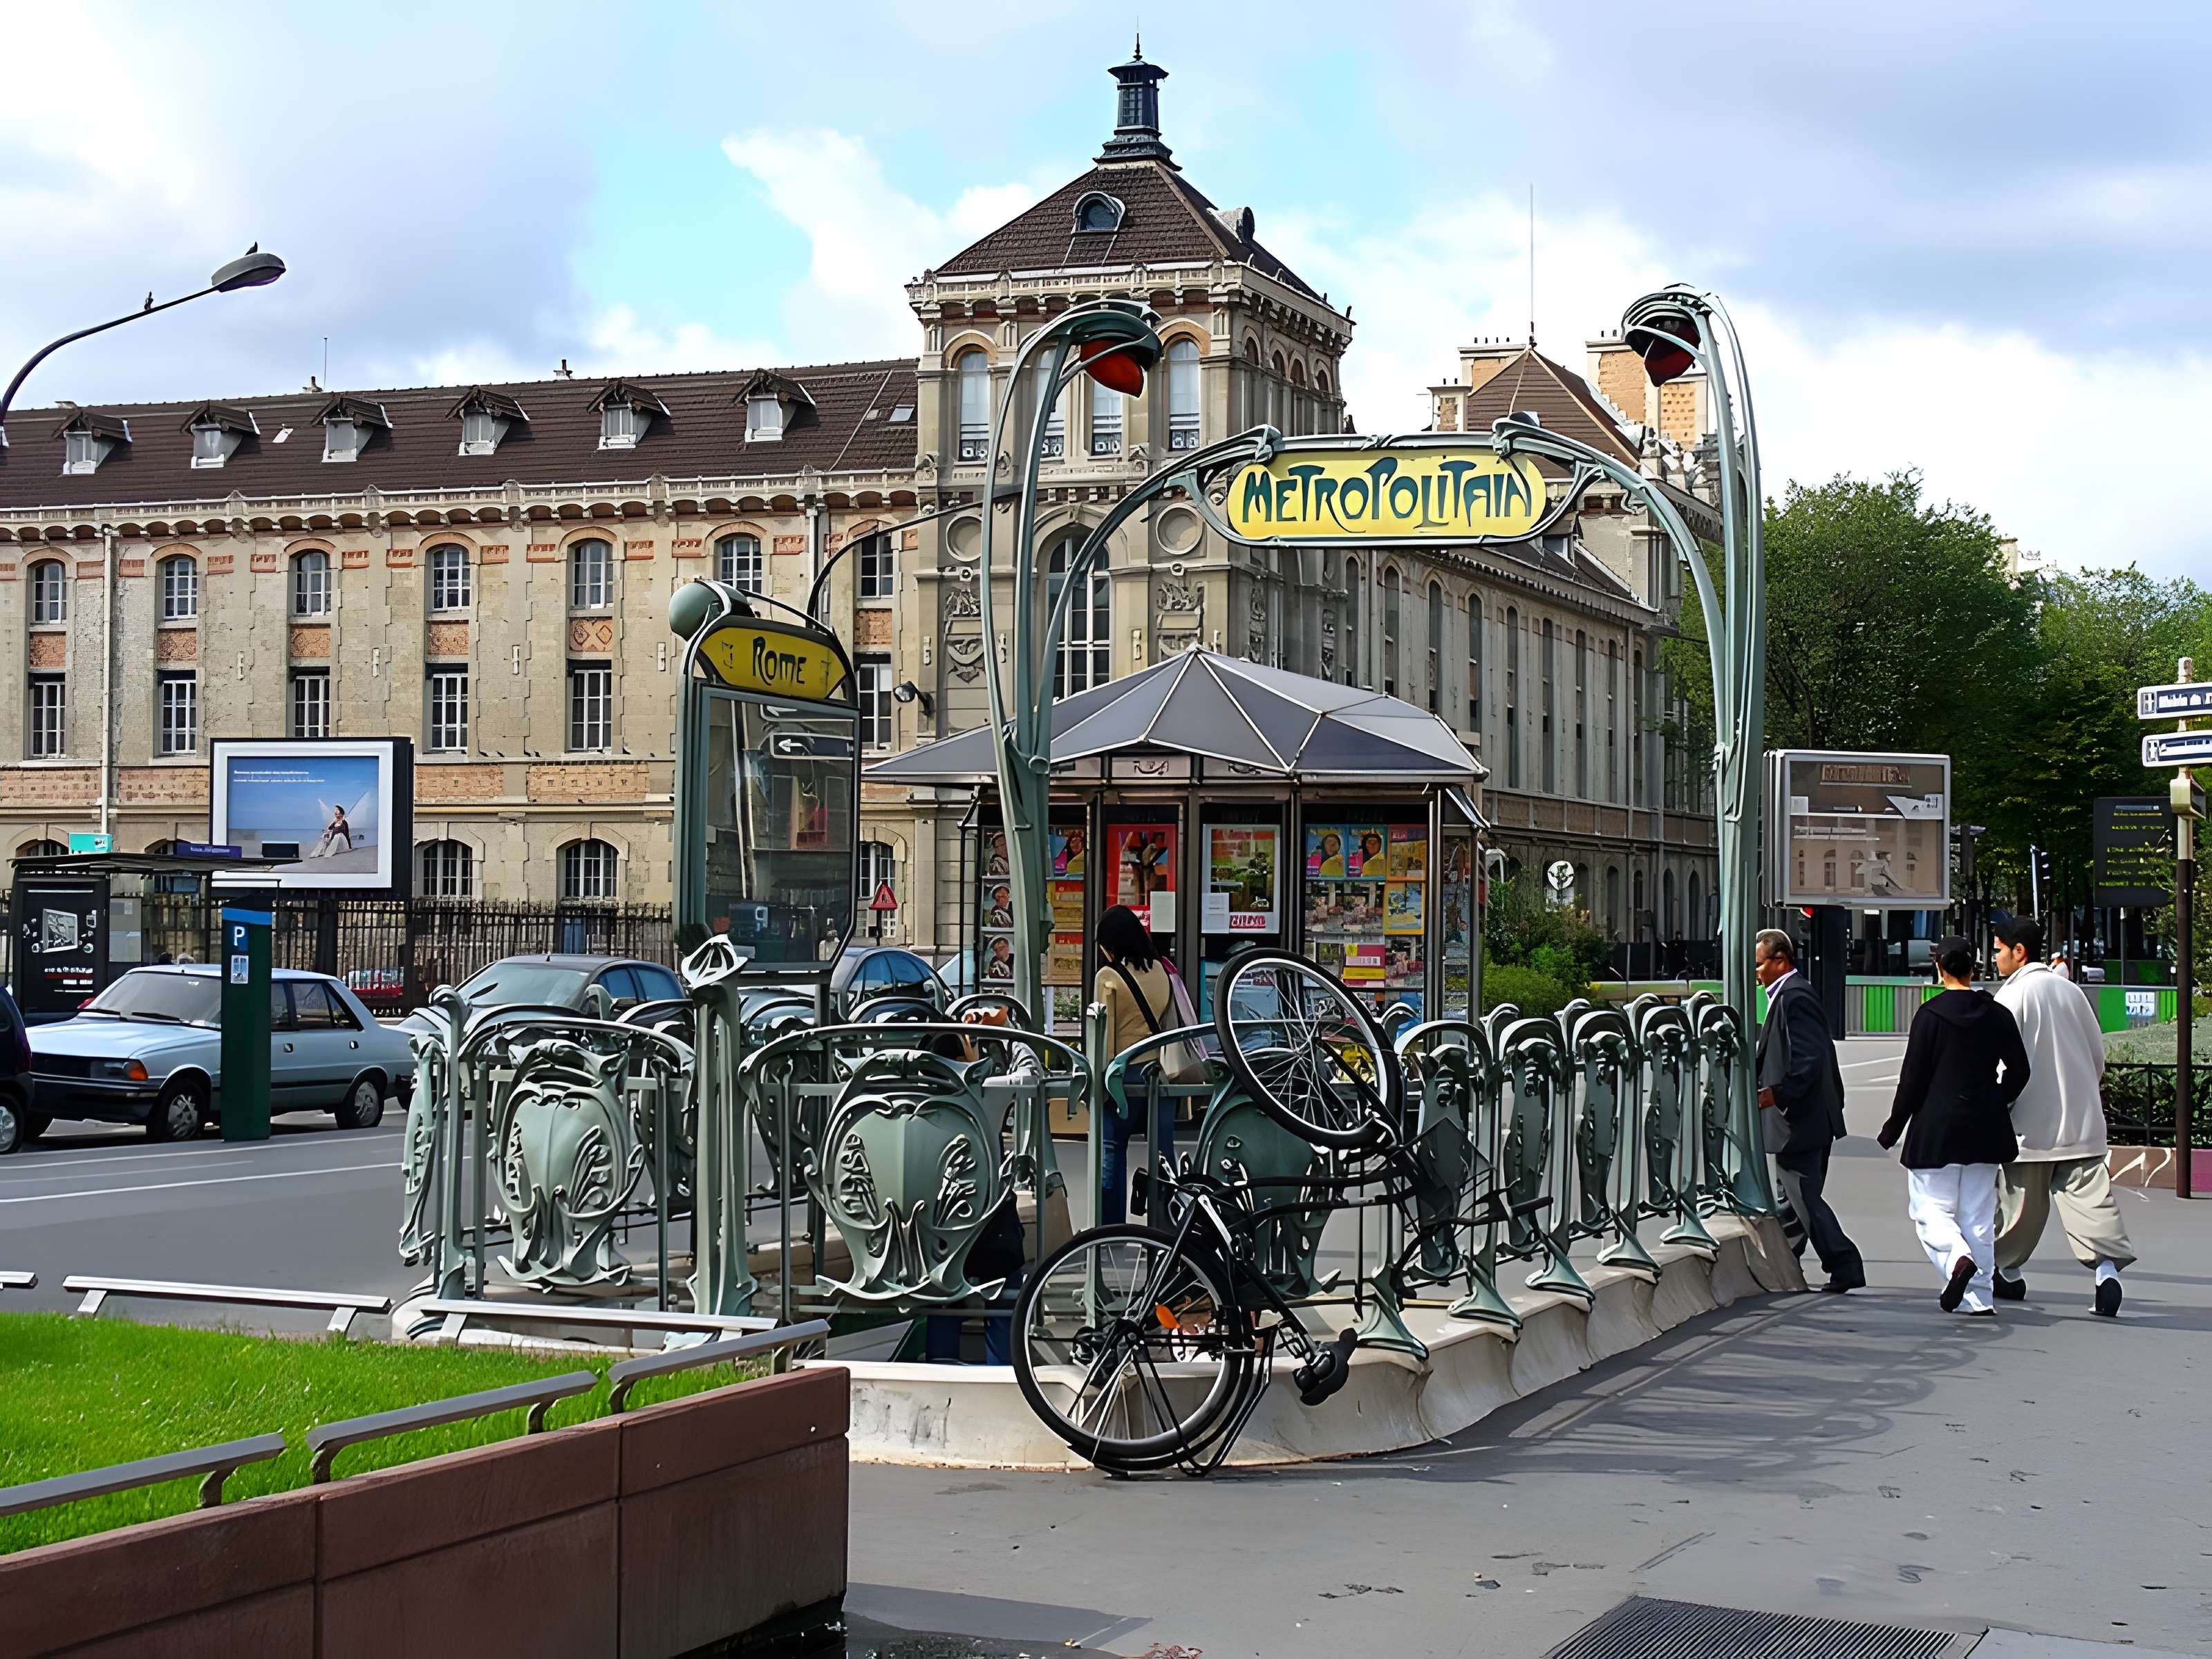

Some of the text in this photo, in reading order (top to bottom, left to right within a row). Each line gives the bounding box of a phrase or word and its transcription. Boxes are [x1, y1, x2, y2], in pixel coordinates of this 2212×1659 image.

[1242, 457, 1532, 532] METROPOLITAIN
[752, 636, 807, 686] ROME
[234, 926, 245, 946] P
